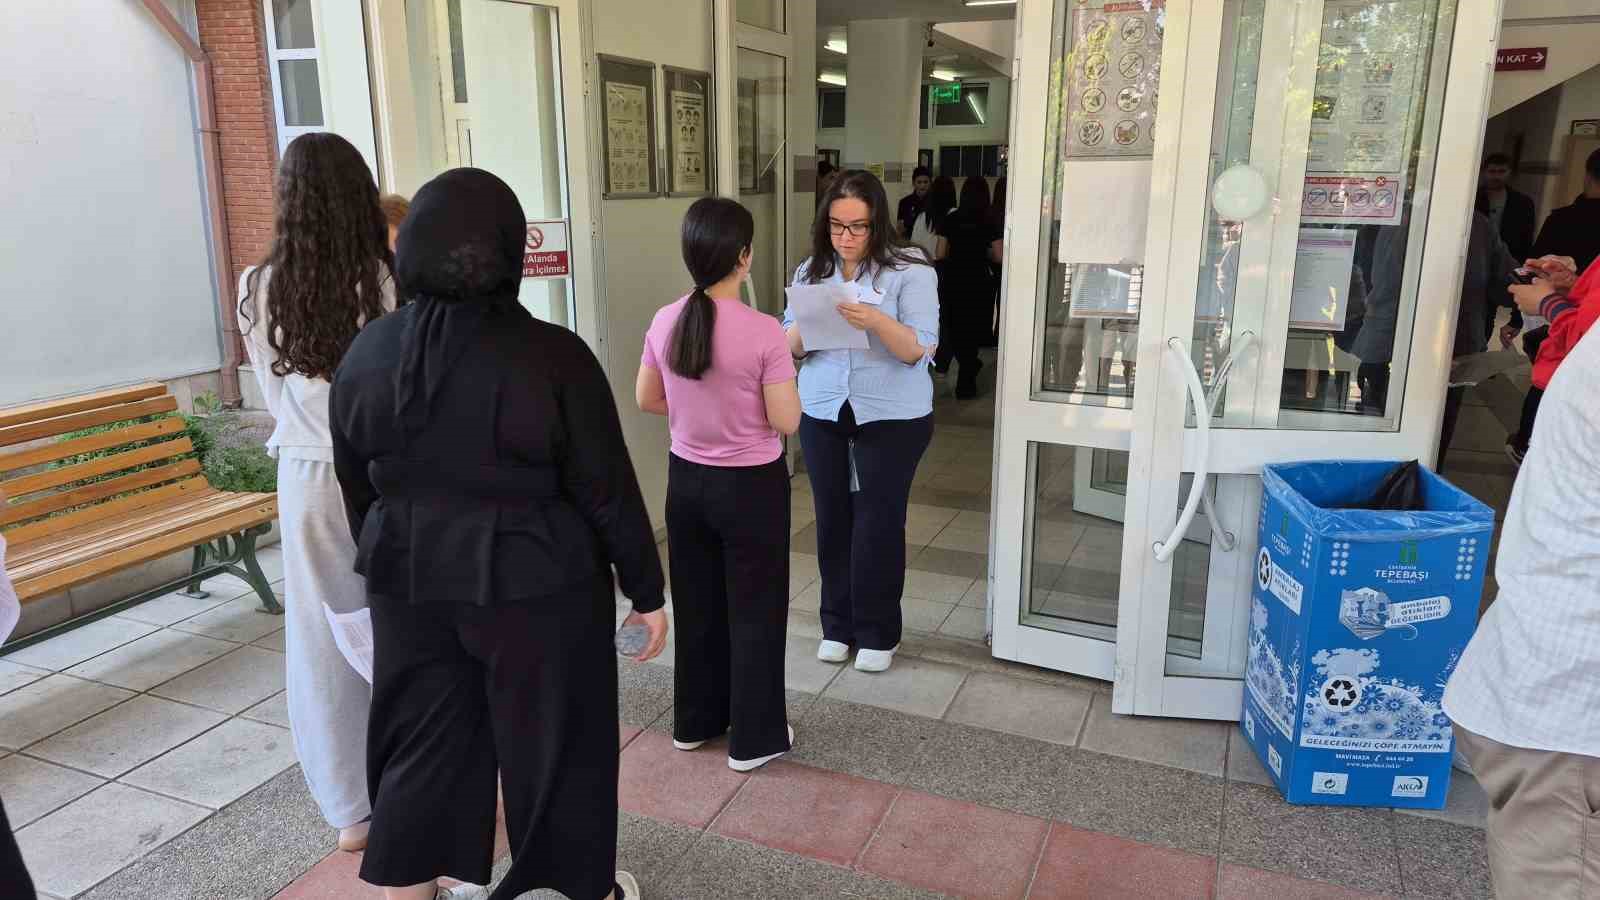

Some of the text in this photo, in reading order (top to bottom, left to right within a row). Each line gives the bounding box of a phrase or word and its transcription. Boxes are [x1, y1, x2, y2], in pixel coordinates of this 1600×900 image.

[1506, 54, 1528, 64] KAT
[527, 254, 558, 264] Alanda
[536, 263, 566, 275] İçilmez
[1375, 569, 1429, 581] TEPEBAŞI
[1305, 738, 1372, 748] GELECEĞİNİZİ
[1374, 741, 1398, 750] ÇÖPE
